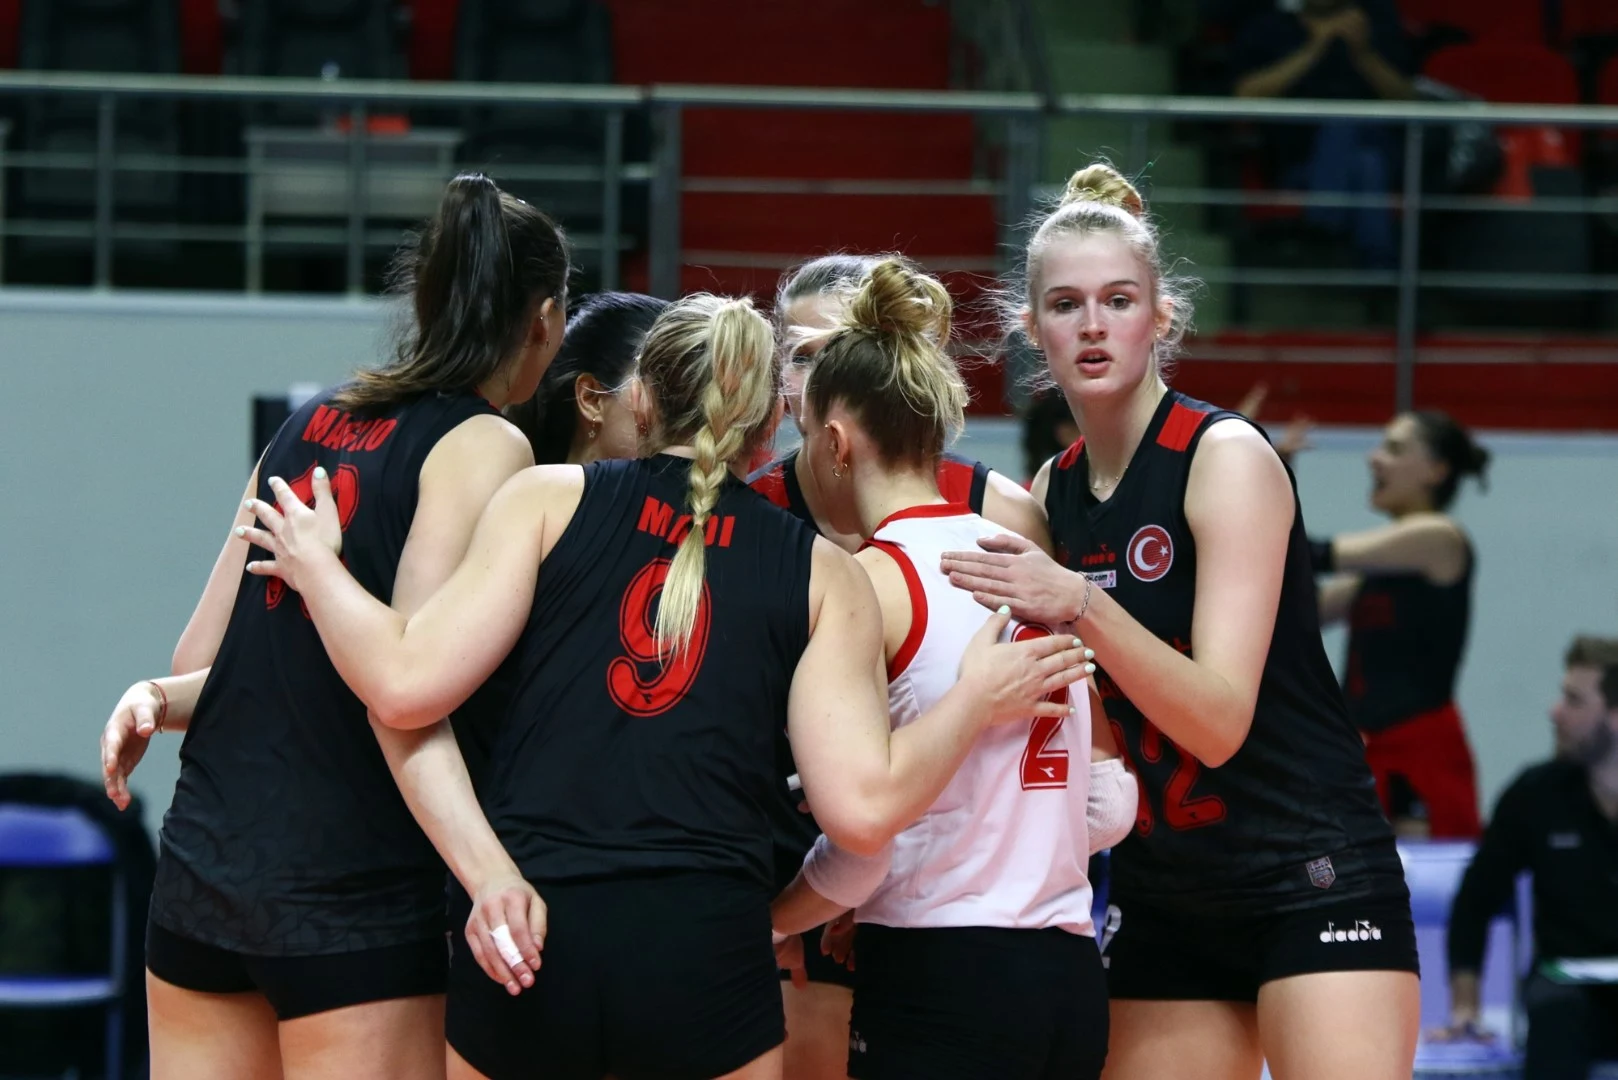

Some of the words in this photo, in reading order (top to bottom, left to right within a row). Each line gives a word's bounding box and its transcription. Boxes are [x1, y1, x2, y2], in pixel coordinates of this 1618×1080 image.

[607, 557, 712, 717] 9
[1010, 621, 1070, 791] 2
[1319, 919, 1382, 943] diadora
